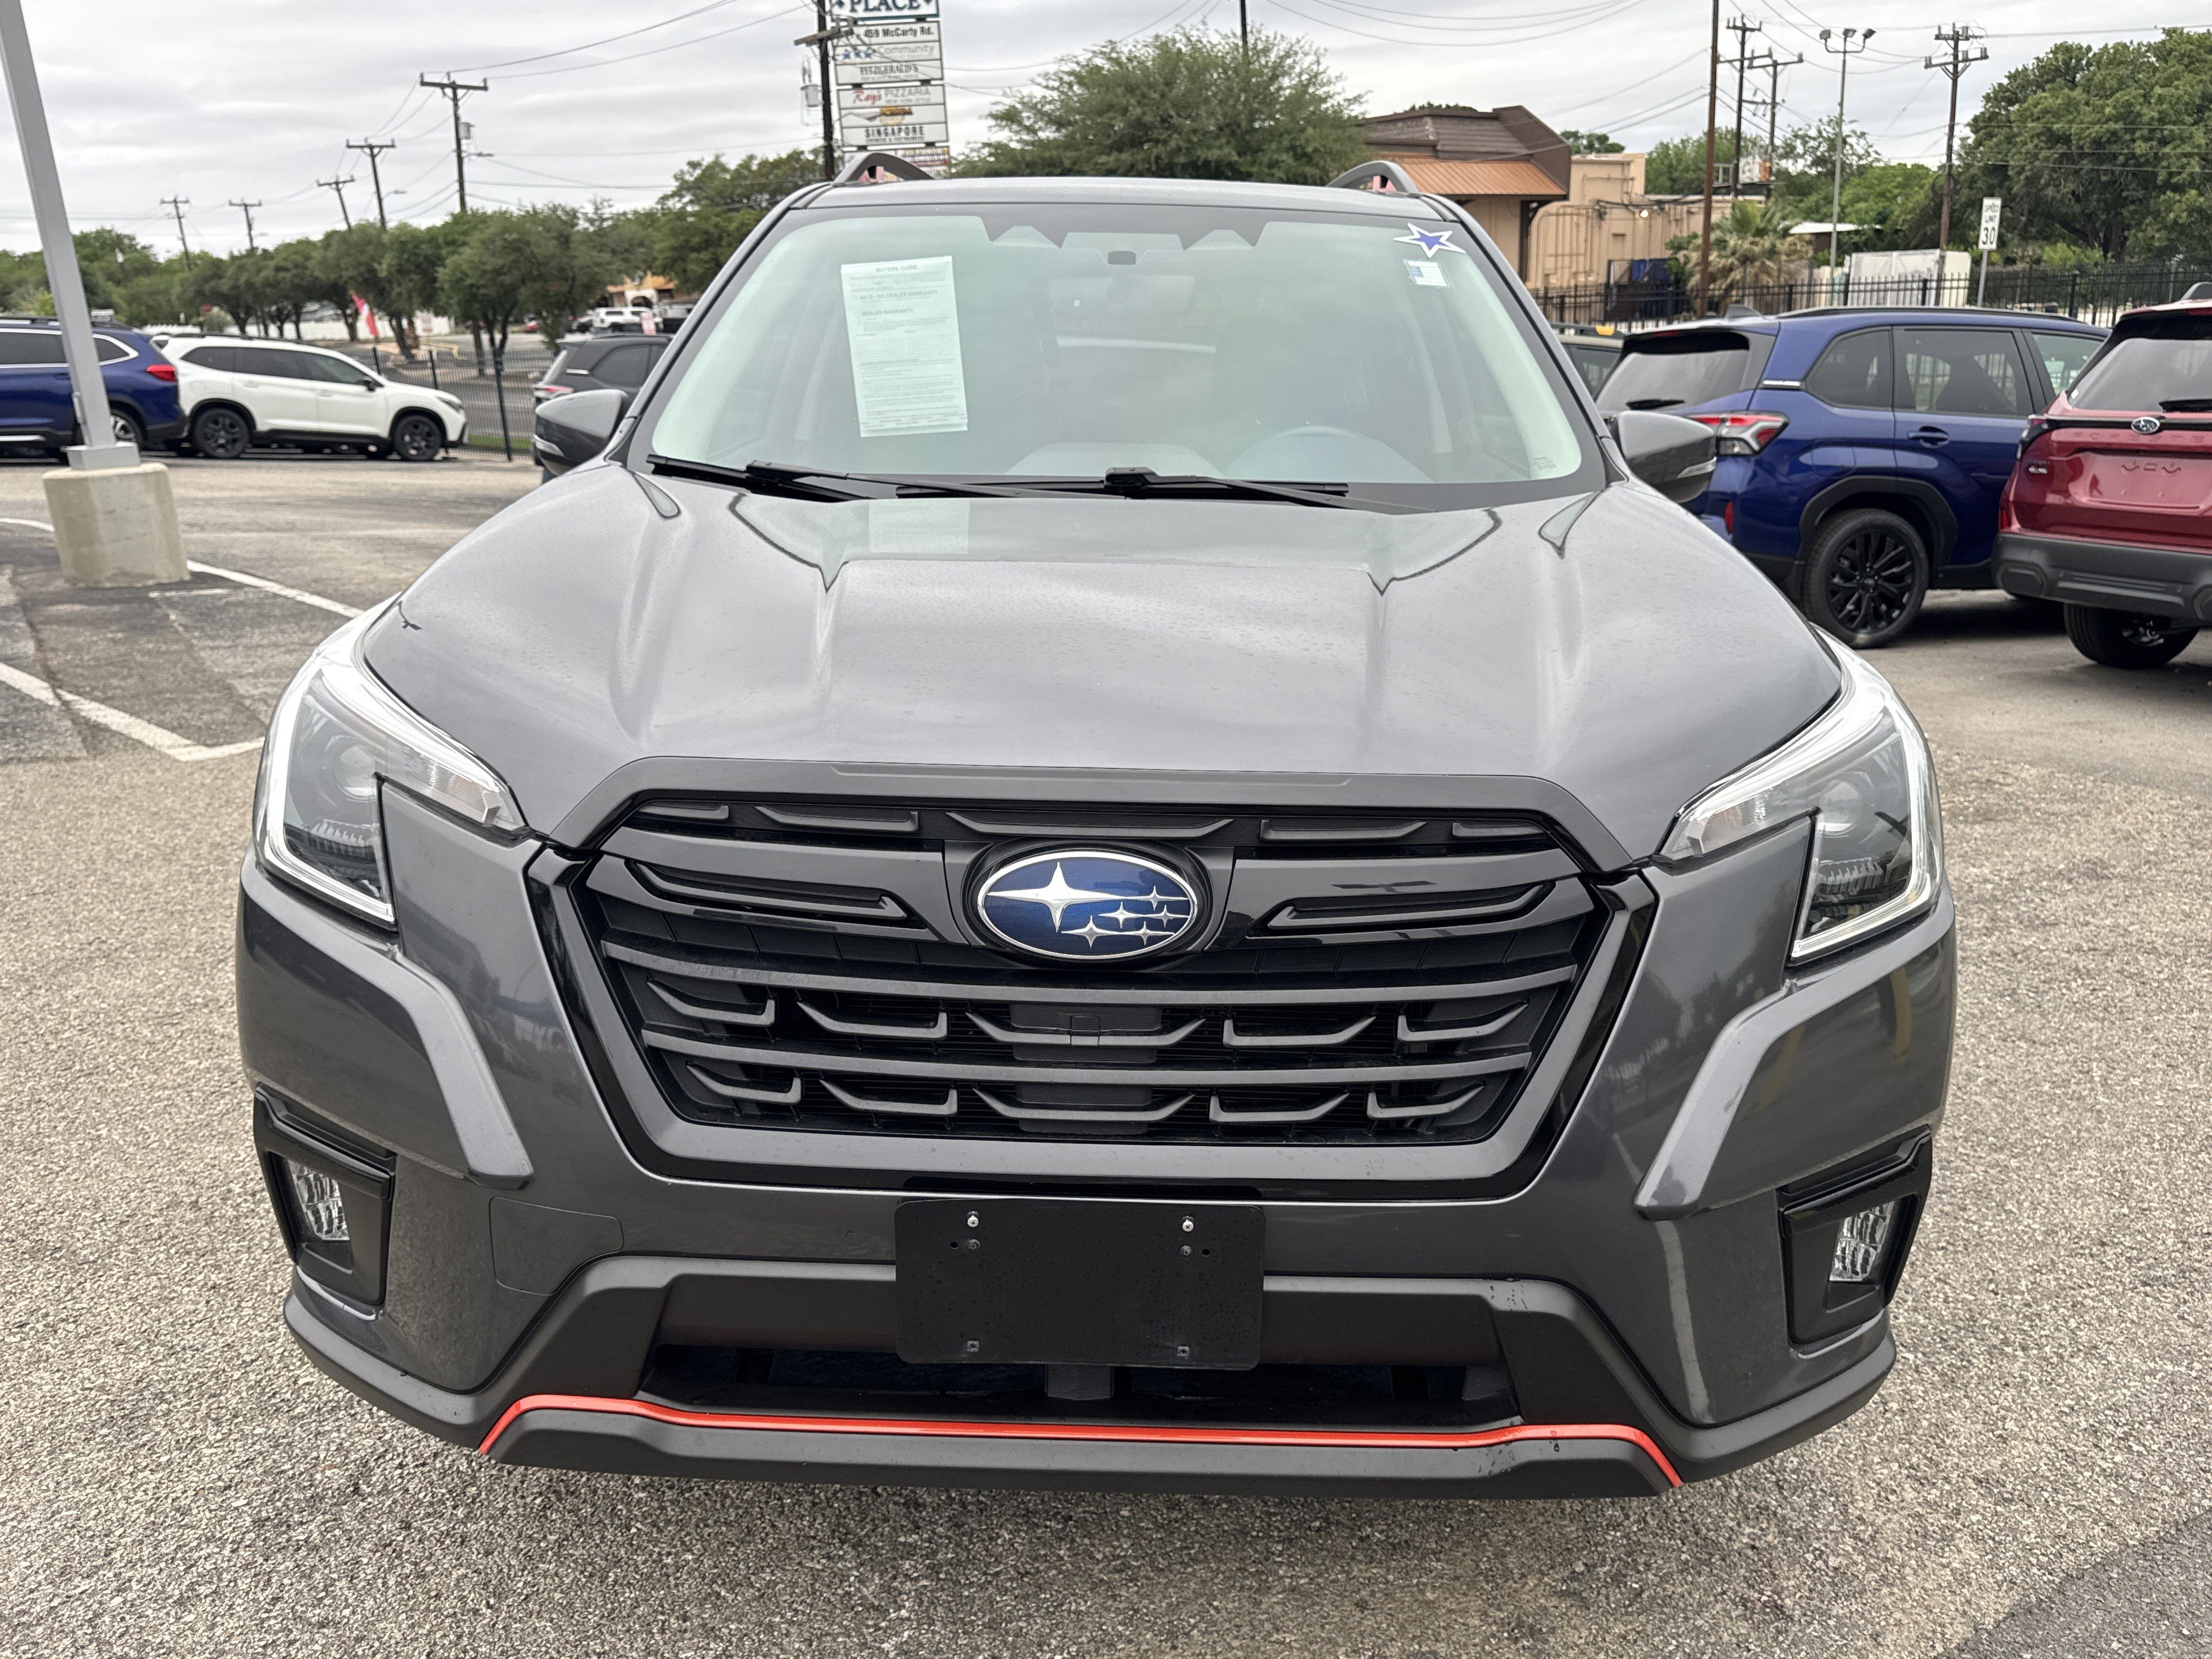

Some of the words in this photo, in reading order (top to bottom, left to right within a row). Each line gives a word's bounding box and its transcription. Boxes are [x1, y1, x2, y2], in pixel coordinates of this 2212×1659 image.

[850, 0, 921, 12] PLACE
[882, 27, 917, 38] McCarty
[878, 44, 935, 54] Community
[865, 126, 924, 138] SINGAPORE
[1982, 226, 1995, 245] 30
